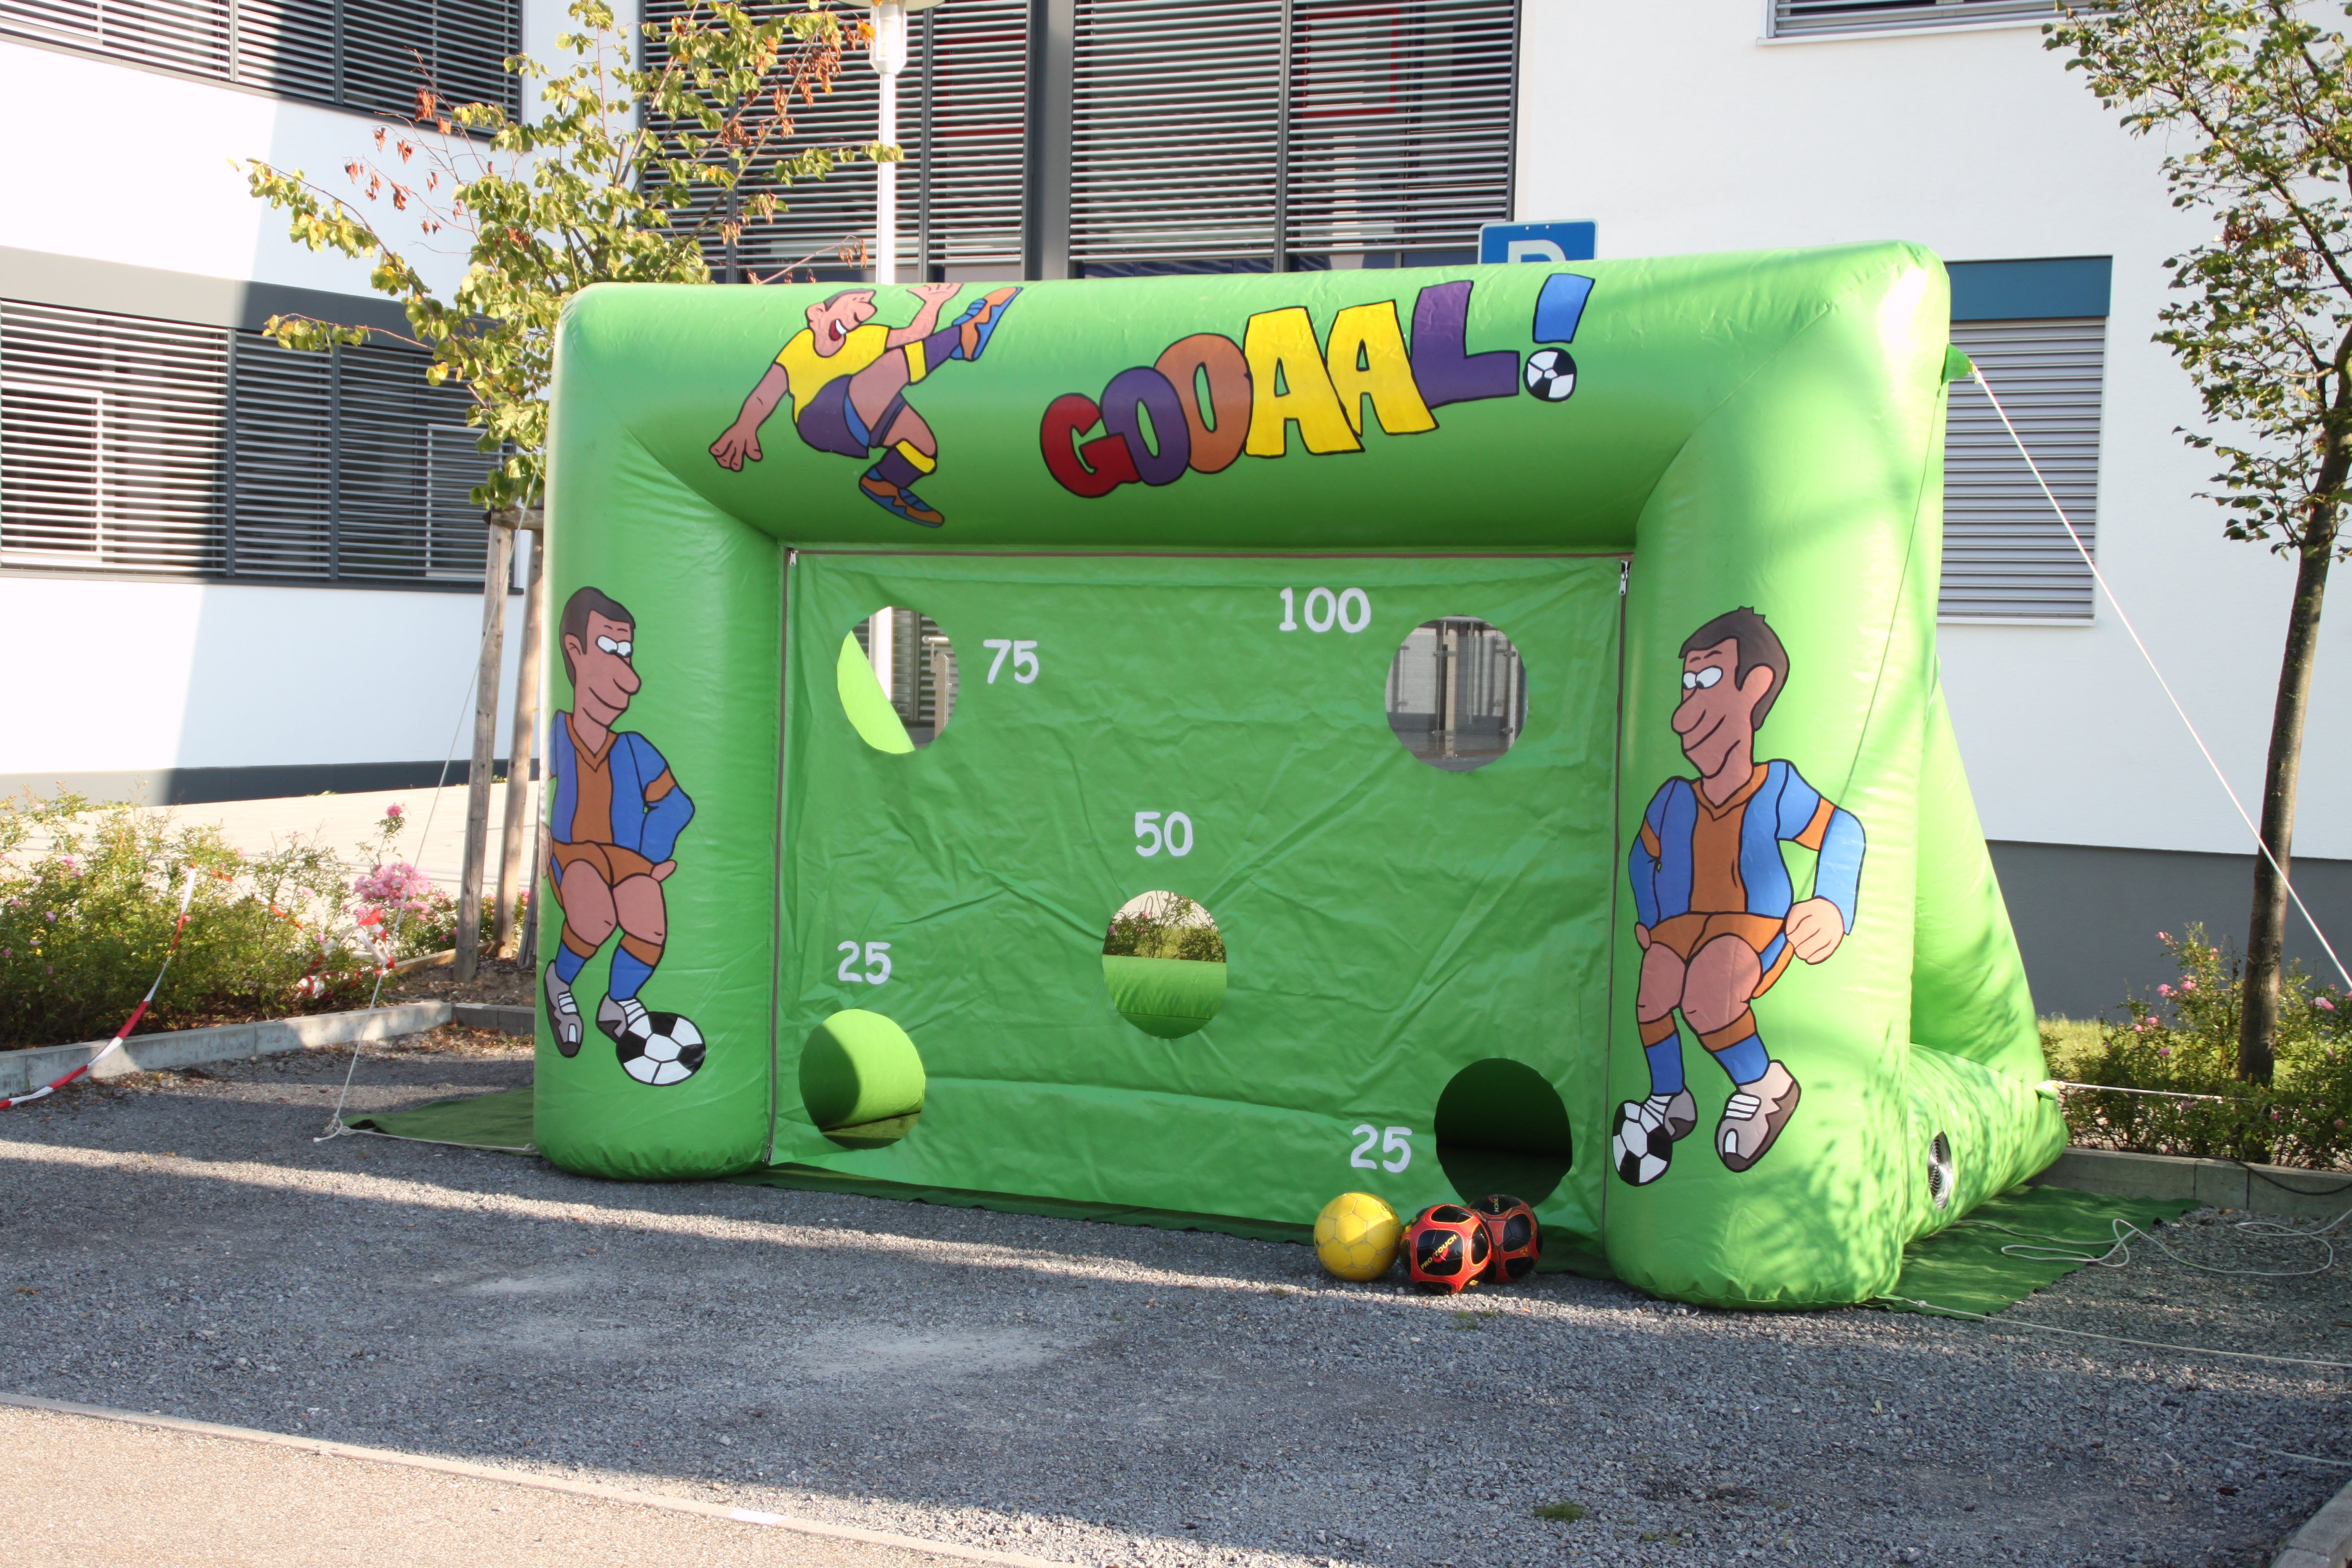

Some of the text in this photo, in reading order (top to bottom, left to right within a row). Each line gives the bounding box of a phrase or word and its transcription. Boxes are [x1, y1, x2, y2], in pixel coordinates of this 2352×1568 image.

[1040, 273, 1595, 497] GOOAAL!
[1279, 587, 1371, 633] 100
[983, 639, 1039, 684] 75
[1135, 811, 1193, 857] 50
[837, 941, 891, 984] 25
[1351, 1124, 1412, 1173] 25
[1421, 1234, 1457, 1270] PRO TOUCH
